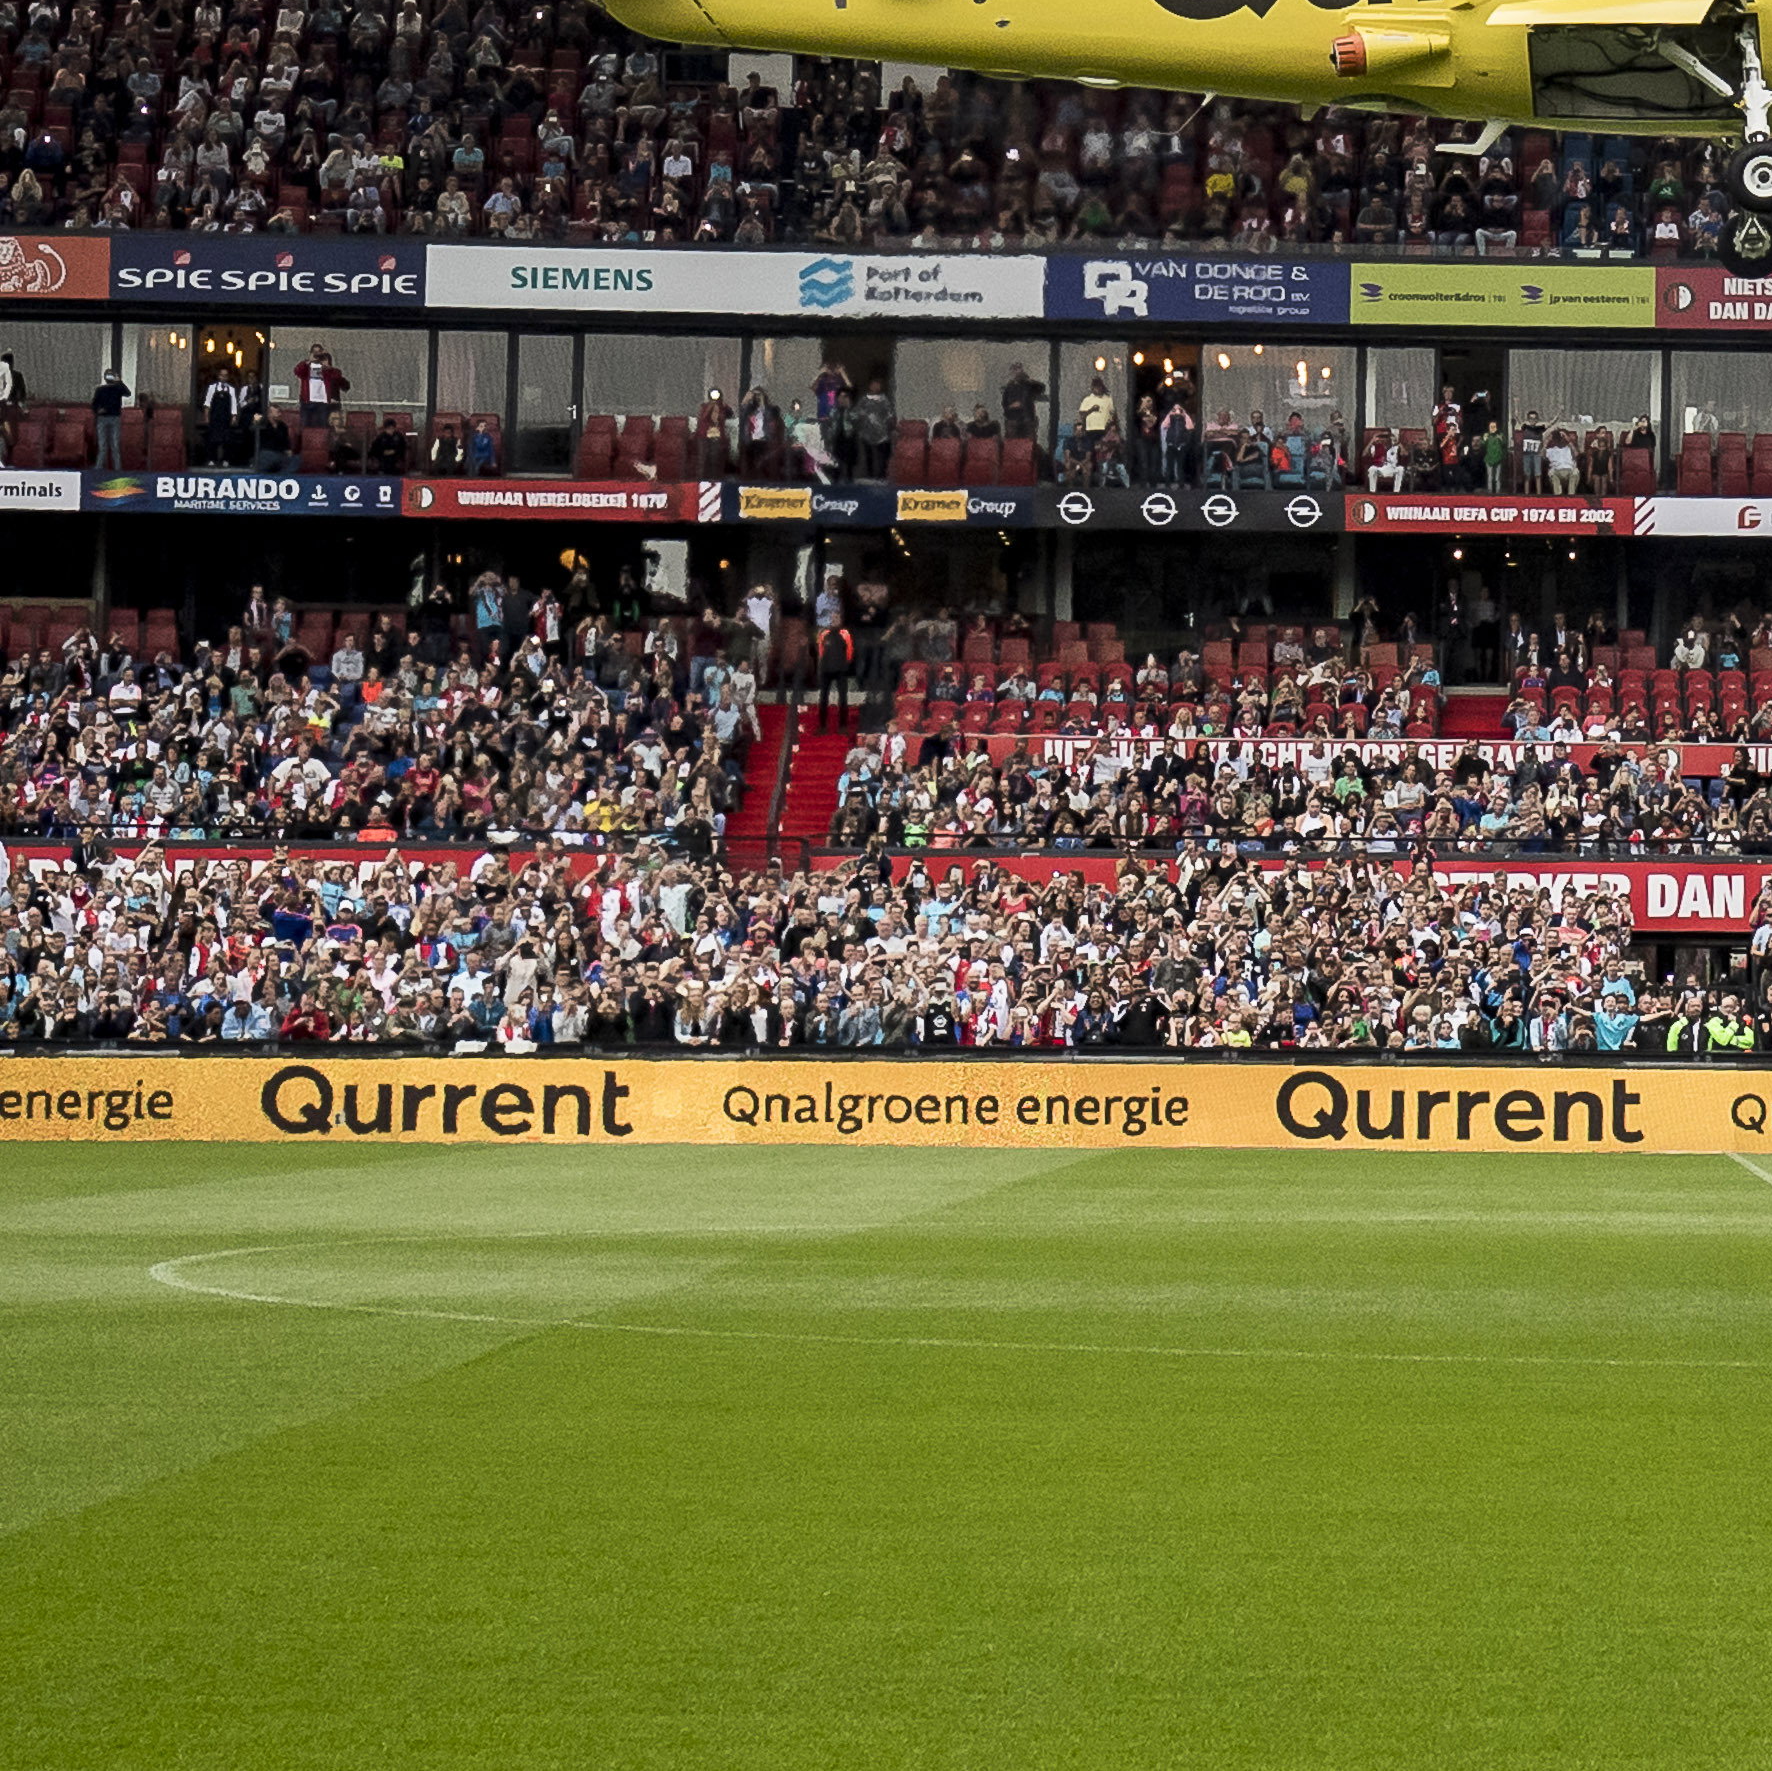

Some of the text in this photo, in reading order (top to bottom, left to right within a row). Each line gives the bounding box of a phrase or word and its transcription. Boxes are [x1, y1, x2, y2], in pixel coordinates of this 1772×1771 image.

[117, 267, 213, 292] SPIE
[220, 269, 316, 294] SPIE
[510, 265, 654, 293] SIEMENS
[866, 262, 942, 283] Port of
[1134, 260, 1188, 279] VAN
[1290, 265, 1310, 281] &
[323, 271, 418, 296] SPIE
[1194, 283, 1230, 301] DE
[1232, 284, 1286, 302] ROO
[1709, 302, 1749, 320] DAN
[156, 476, 300, 500] BURANDO
[457, 490, 524, 507] WINNAAR
[229, 500, 280, 511] SERVICES
[967, 498, 1016, 517] Group
[1386, 506, 1615, 524] WINNAAR UEFA CUP 1974 EN 2002
[1647, 874, 1745, 918] DAN
[0, 1080, 173, 1131] energie
[261, 1065, 634, 1136] Qurrent
[723, 1082, 1189, 1136] Qnalgroene energie
[1276, 1071, 1644, 1143] Qurrent
